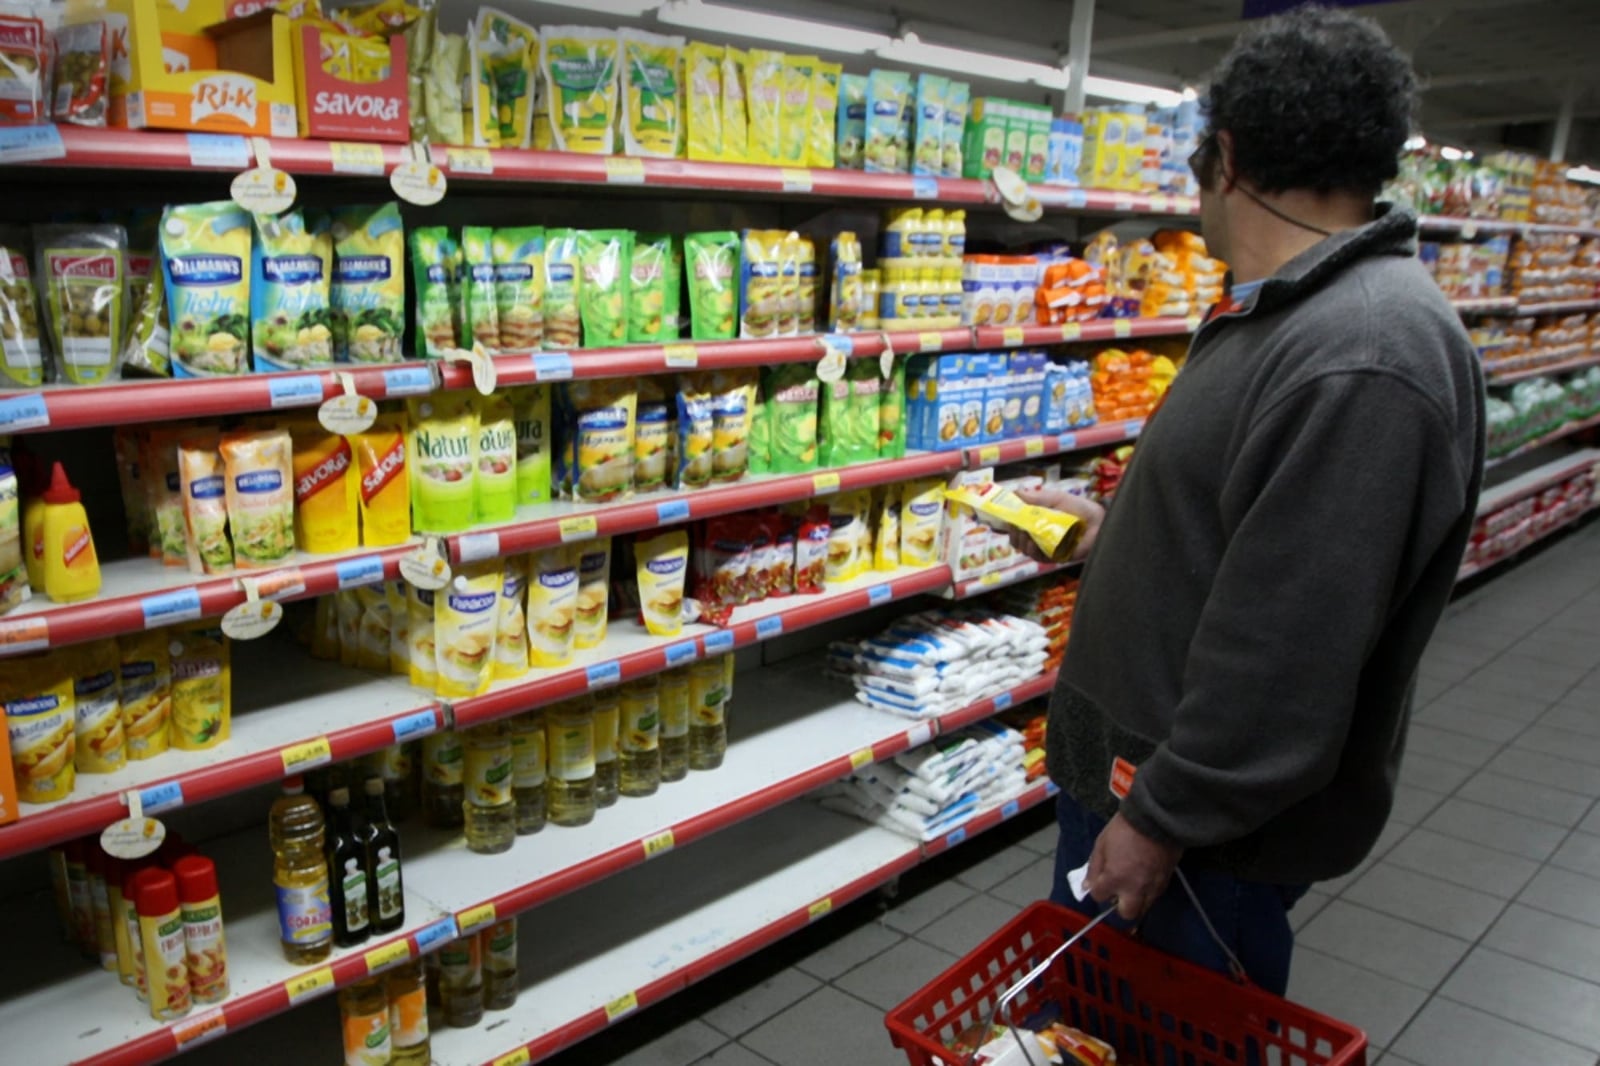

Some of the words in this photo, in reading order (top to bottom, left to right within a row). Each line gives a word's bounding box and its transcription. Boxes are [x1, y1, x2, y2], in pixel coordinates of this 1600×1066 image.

[480, 429, 512, 452] atur
[517, 419, 542, 440] ura
[417, 430, 469, 459] Natur
